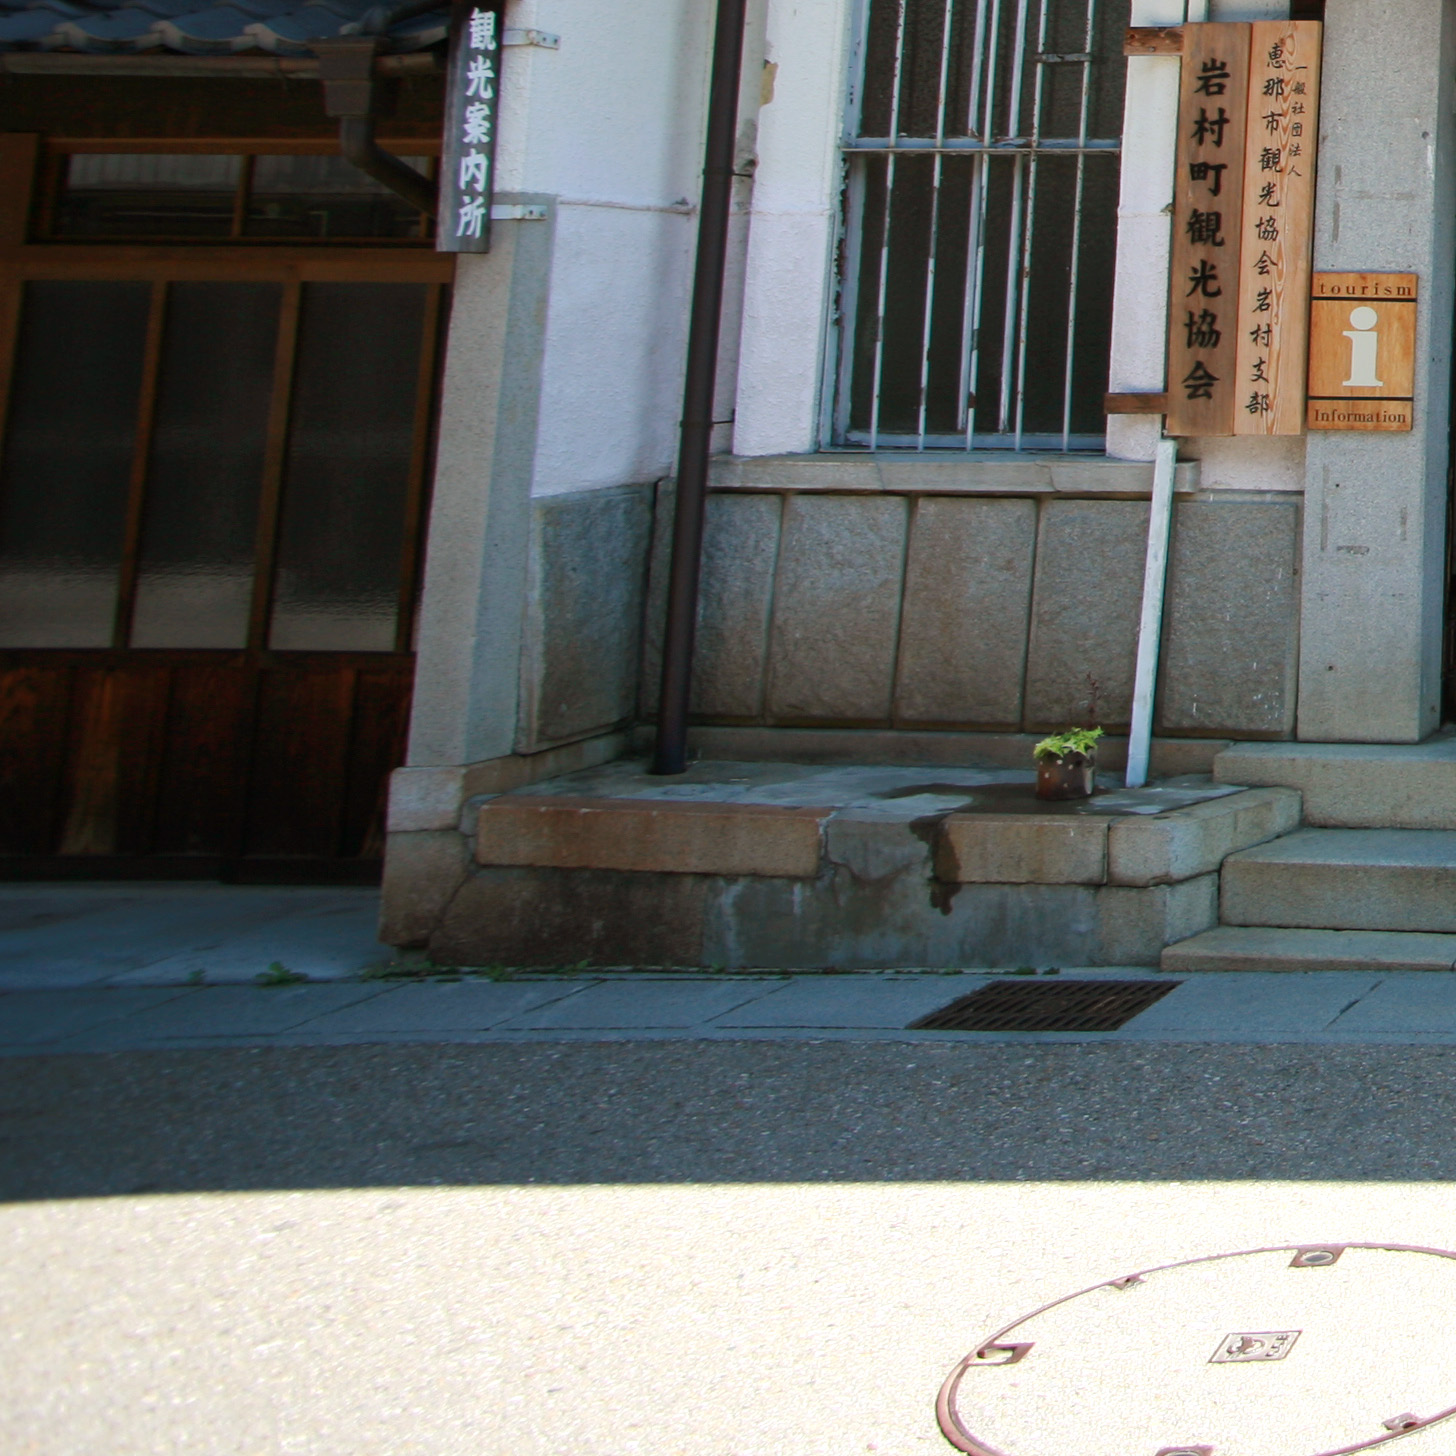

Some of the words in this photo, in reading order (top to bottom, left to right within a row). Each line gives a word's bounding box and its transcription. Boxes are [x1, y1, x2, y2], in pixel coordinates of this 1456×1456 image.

[456, 7, 497, 239] 観光案内所
[1286, 65, 1308, 178] 一般社団法人
[1182, 57, 1231, 401] 岩村町観光協会
[1245, 43, 1286, 417] 恵那市観光協会岩村支部
[1319, 282, 1413, 297] tourism
[1314, 408, 1407, 425] Information
